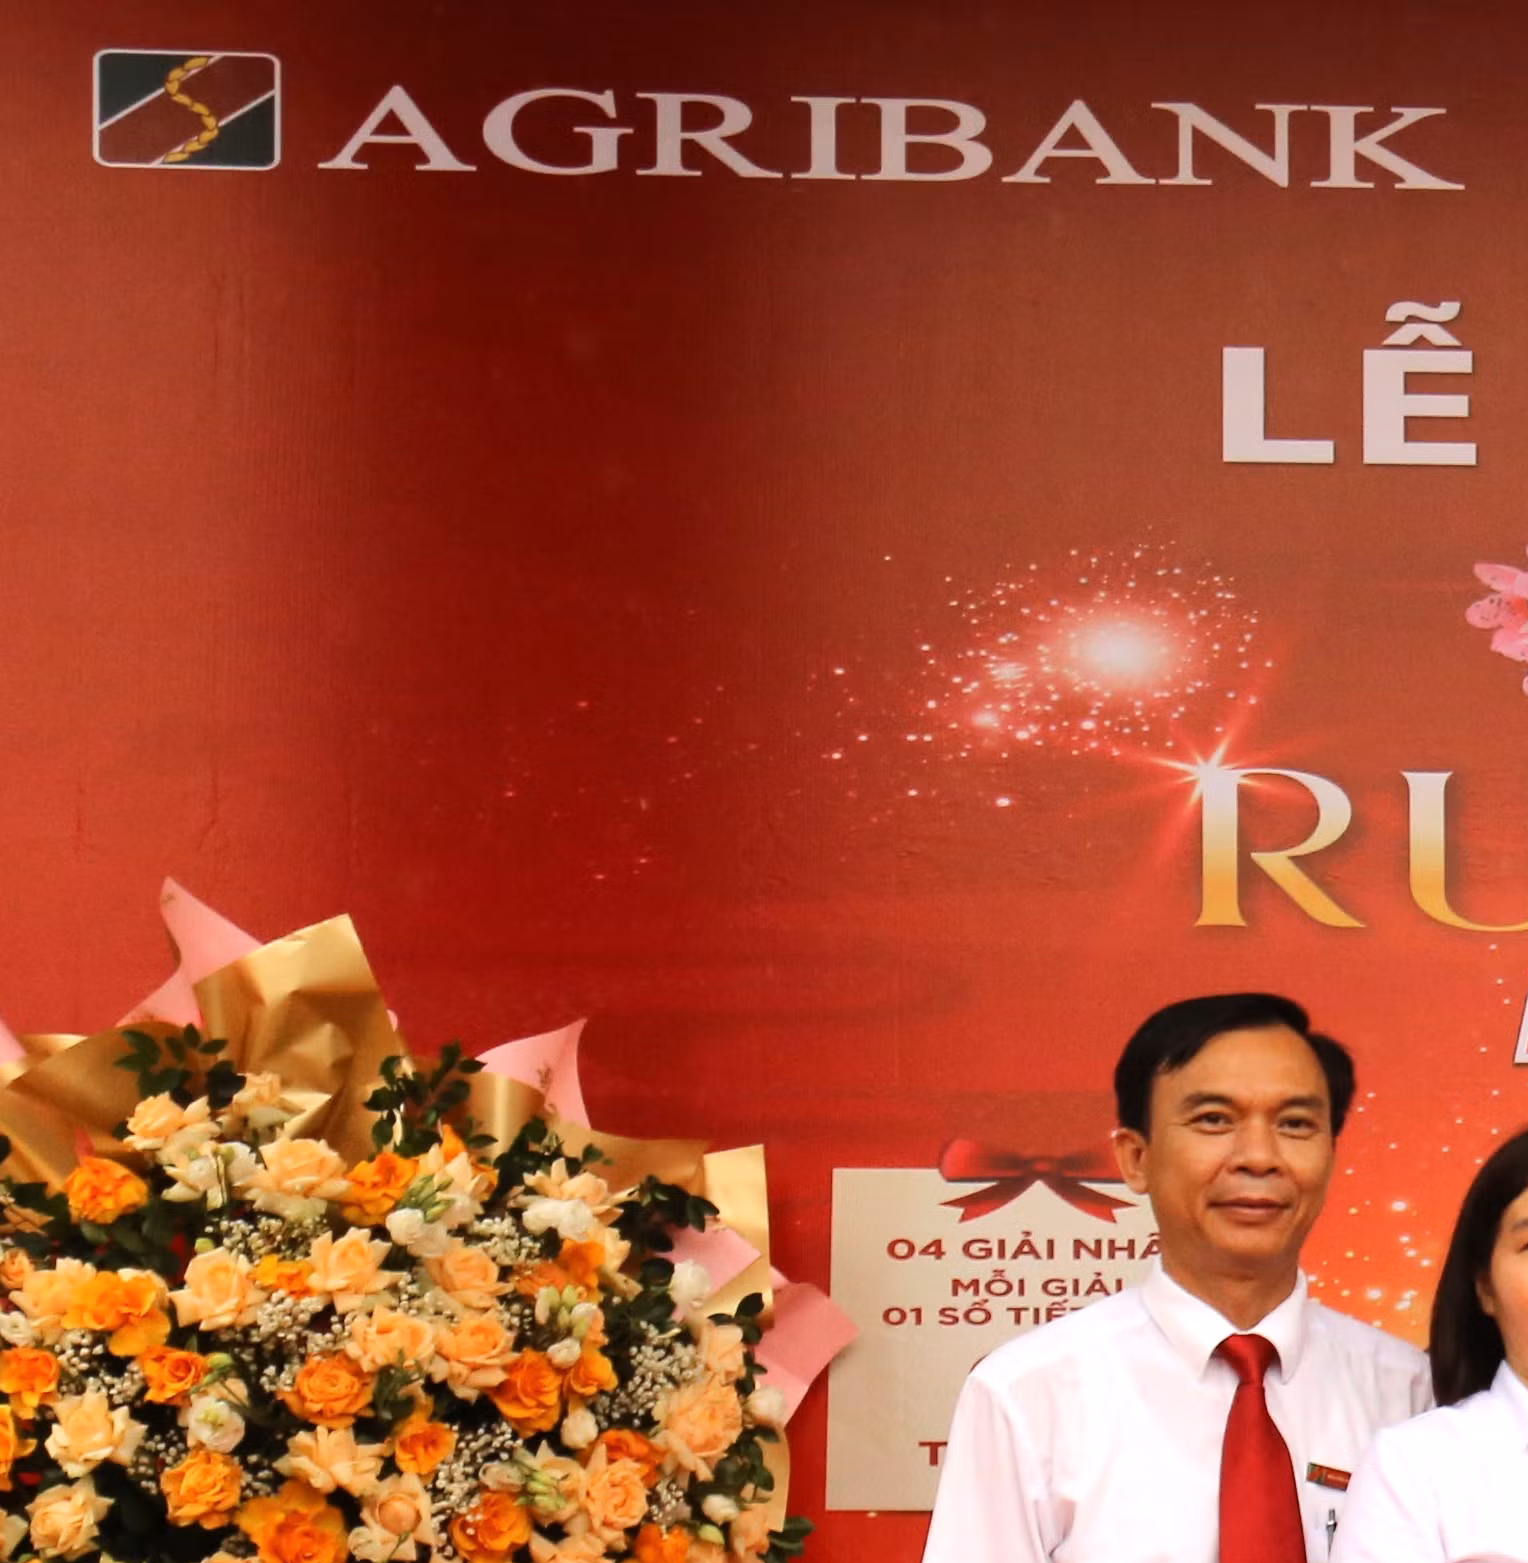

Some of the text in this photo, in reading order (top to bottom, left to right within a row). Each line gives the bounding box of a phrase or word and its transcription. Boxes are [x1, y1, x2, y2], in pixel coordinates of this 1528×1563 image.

[317, 84, 1465, 190] AGRIBANK
[1222, 301, 1478, 466] LỄ
[886, 1238, 946, 1260] 04
[962, 1231, 1055, 1260] GIẢI
[951, 1269, 1124, 1297] MỖI GIẢI
[881, 1307, 923, 1325] 01
[1006, 1299, 1089, 1325] TIẾ
